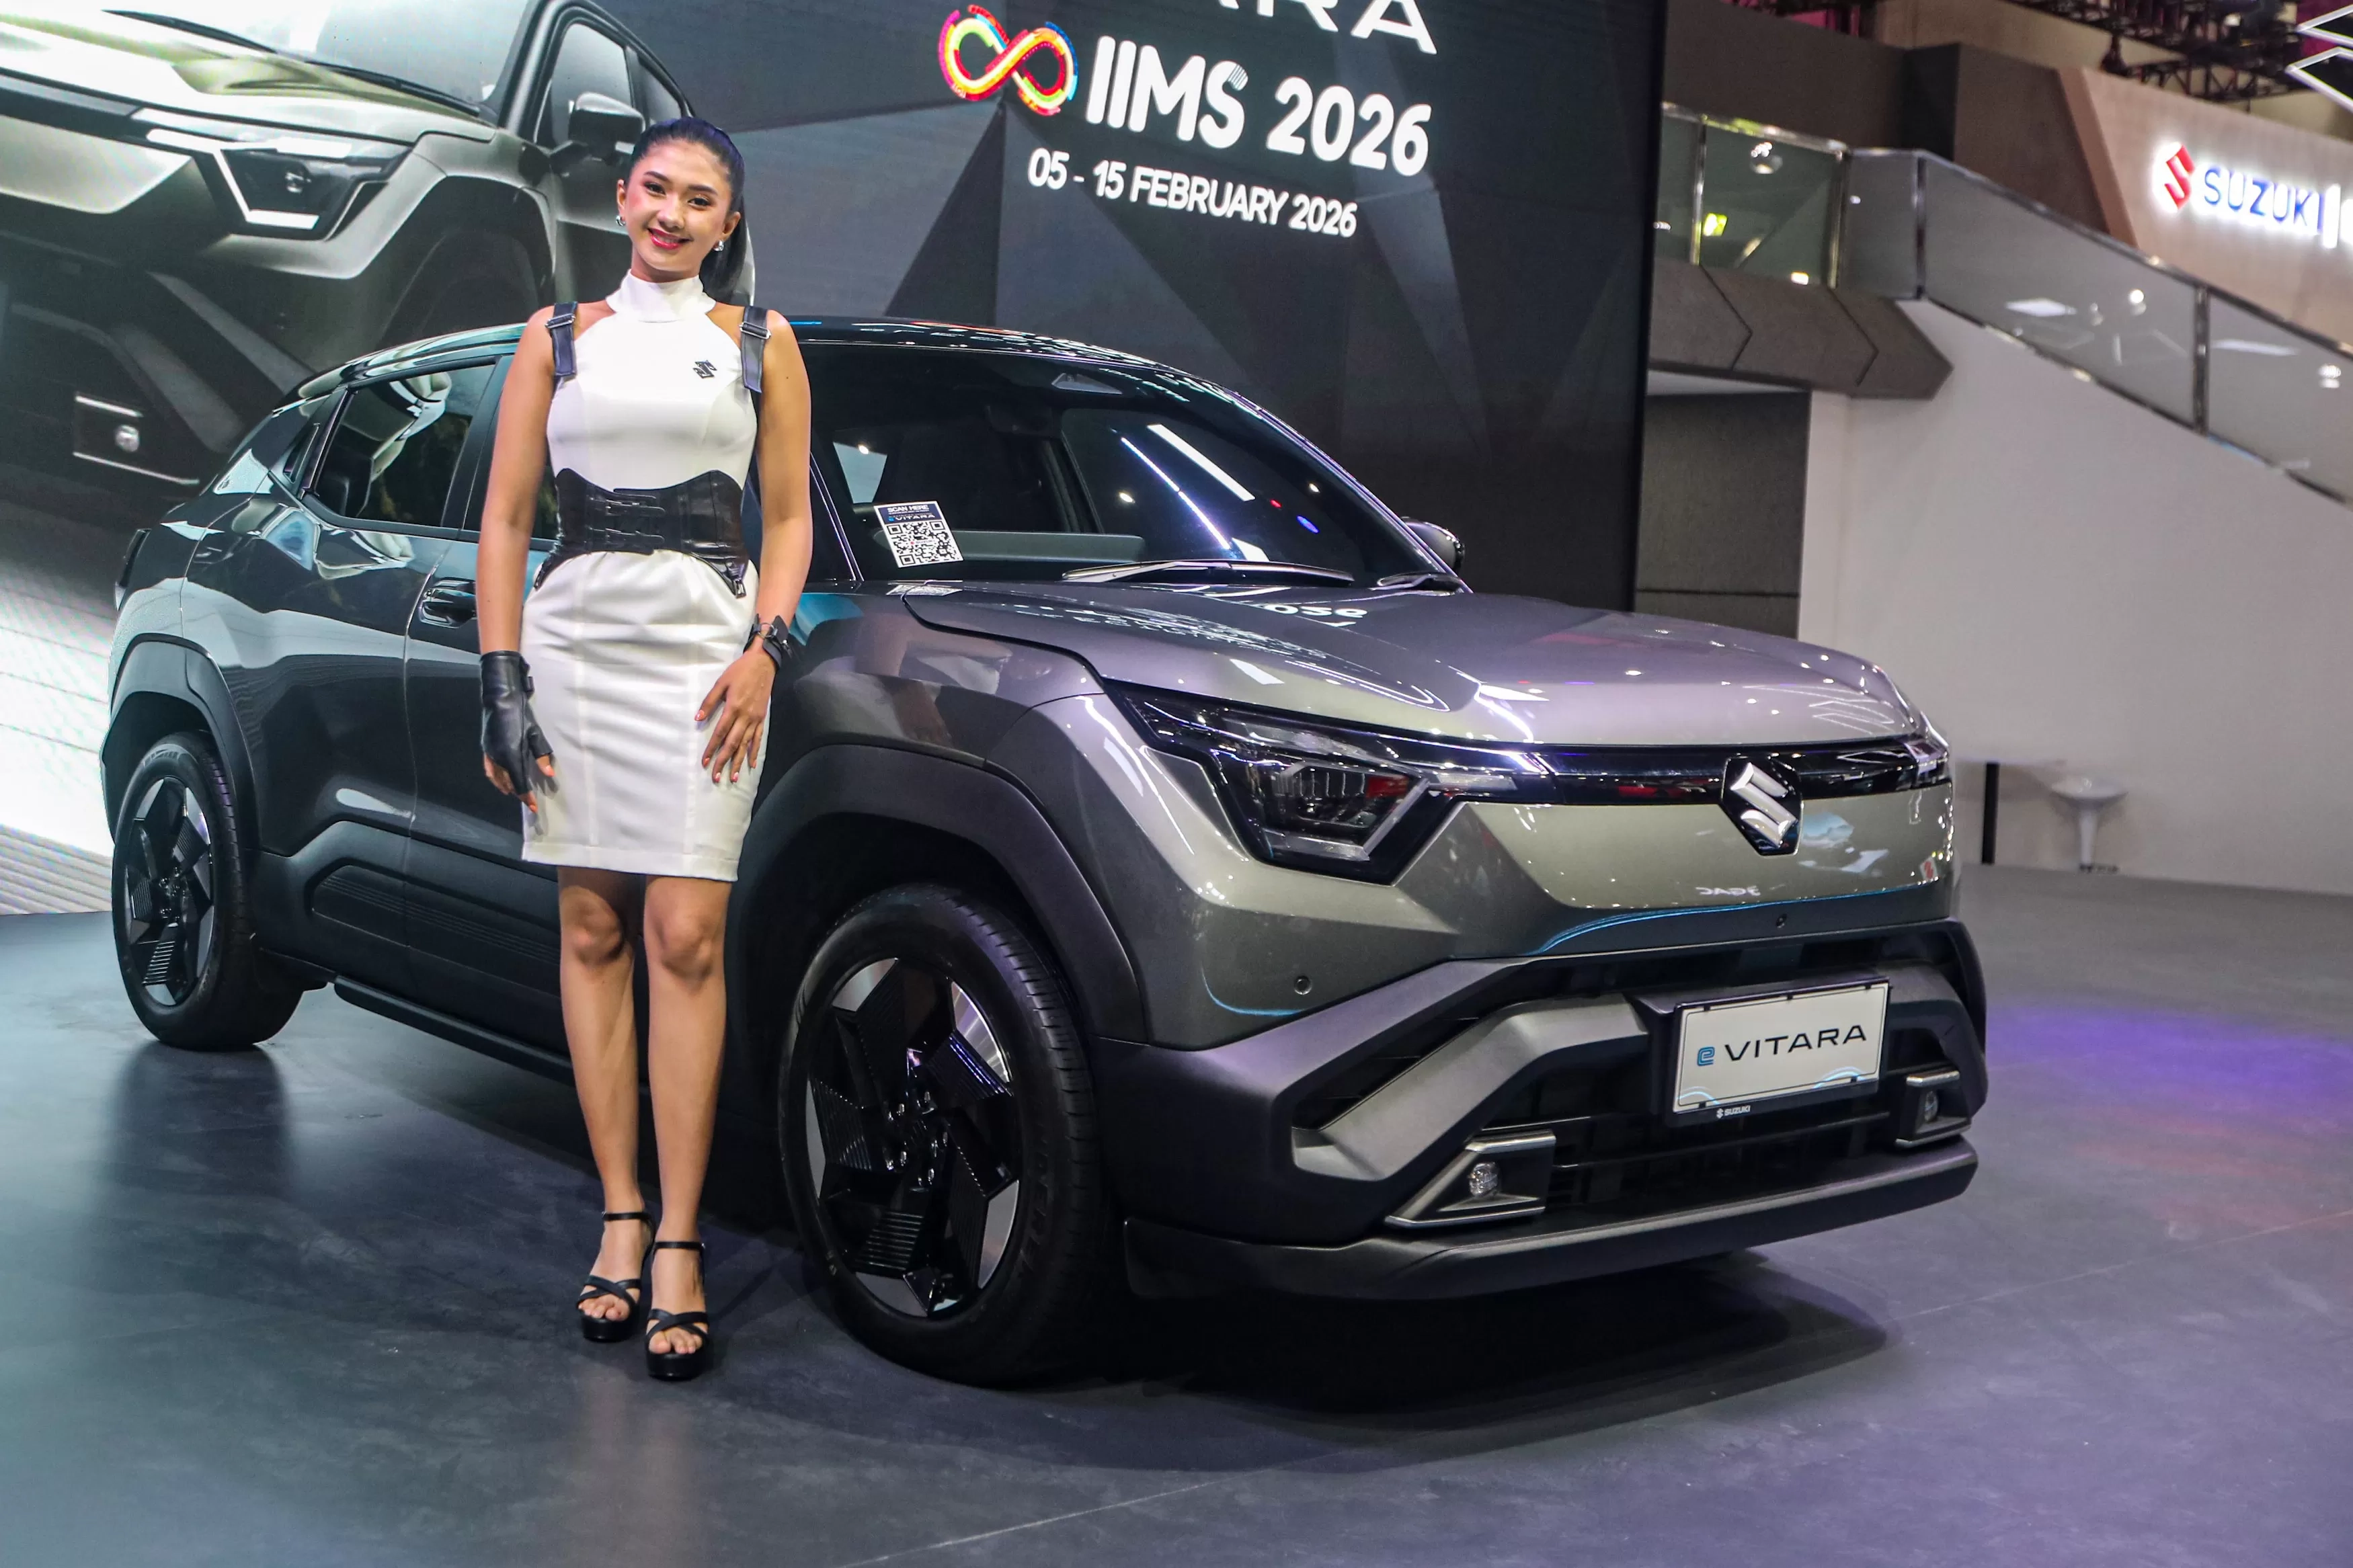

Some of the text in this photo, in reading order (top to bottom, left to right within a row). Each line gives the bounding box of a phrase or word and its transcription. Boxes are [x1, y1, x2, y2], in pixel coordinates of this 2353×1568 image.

[1086, 36, 1433, 177] IIMS 2026
[1027, 147, 1070, 190] 05
[1093, 160, 1127, 200] 15
[1129, 166, 1290, 225] FEBRUARY
[1289, 194, 1358, 237] 2026
[2204, 165, 2325, 233] SUZUKI
[1724, 1025, 1867, 1061] VITARA
[1724, 1105, 1751, 1116] SUZUKI
